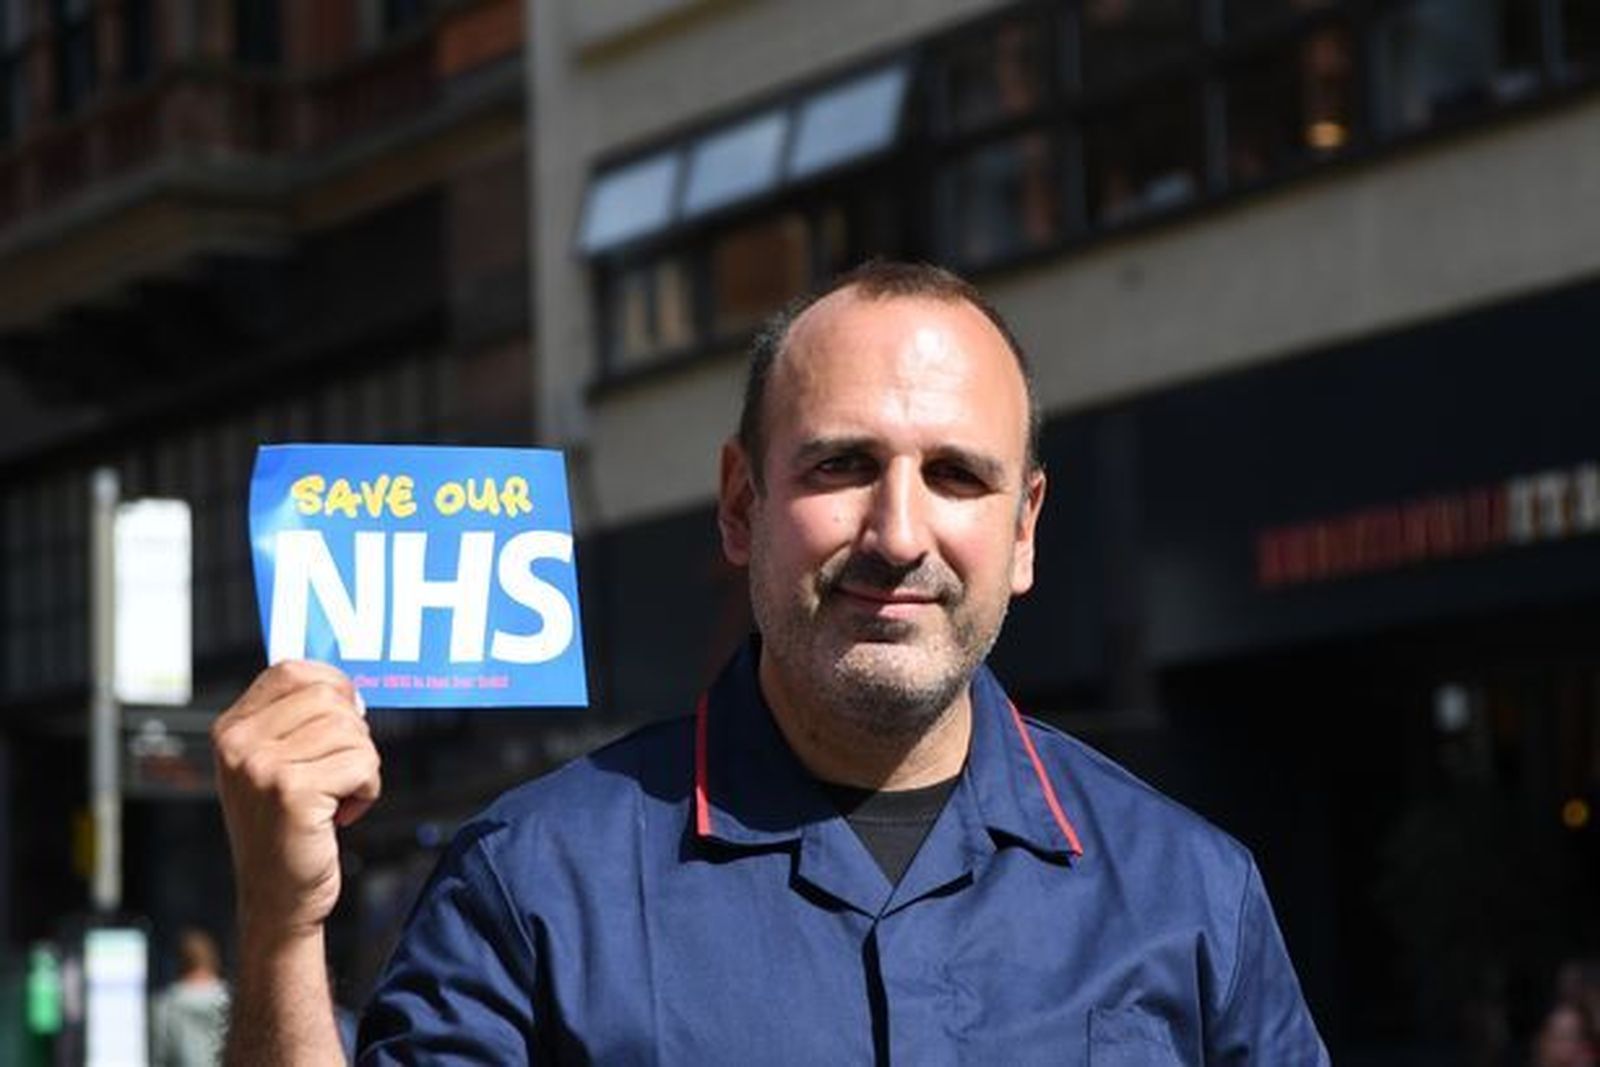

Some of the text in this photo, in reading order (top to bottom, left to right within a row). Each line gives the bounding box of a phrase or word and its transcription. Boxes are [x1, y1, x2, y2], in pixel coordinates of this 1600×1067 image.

[290, 474, 533, 517] SAVE OUR
[268, 529, 574, 664] NHS
